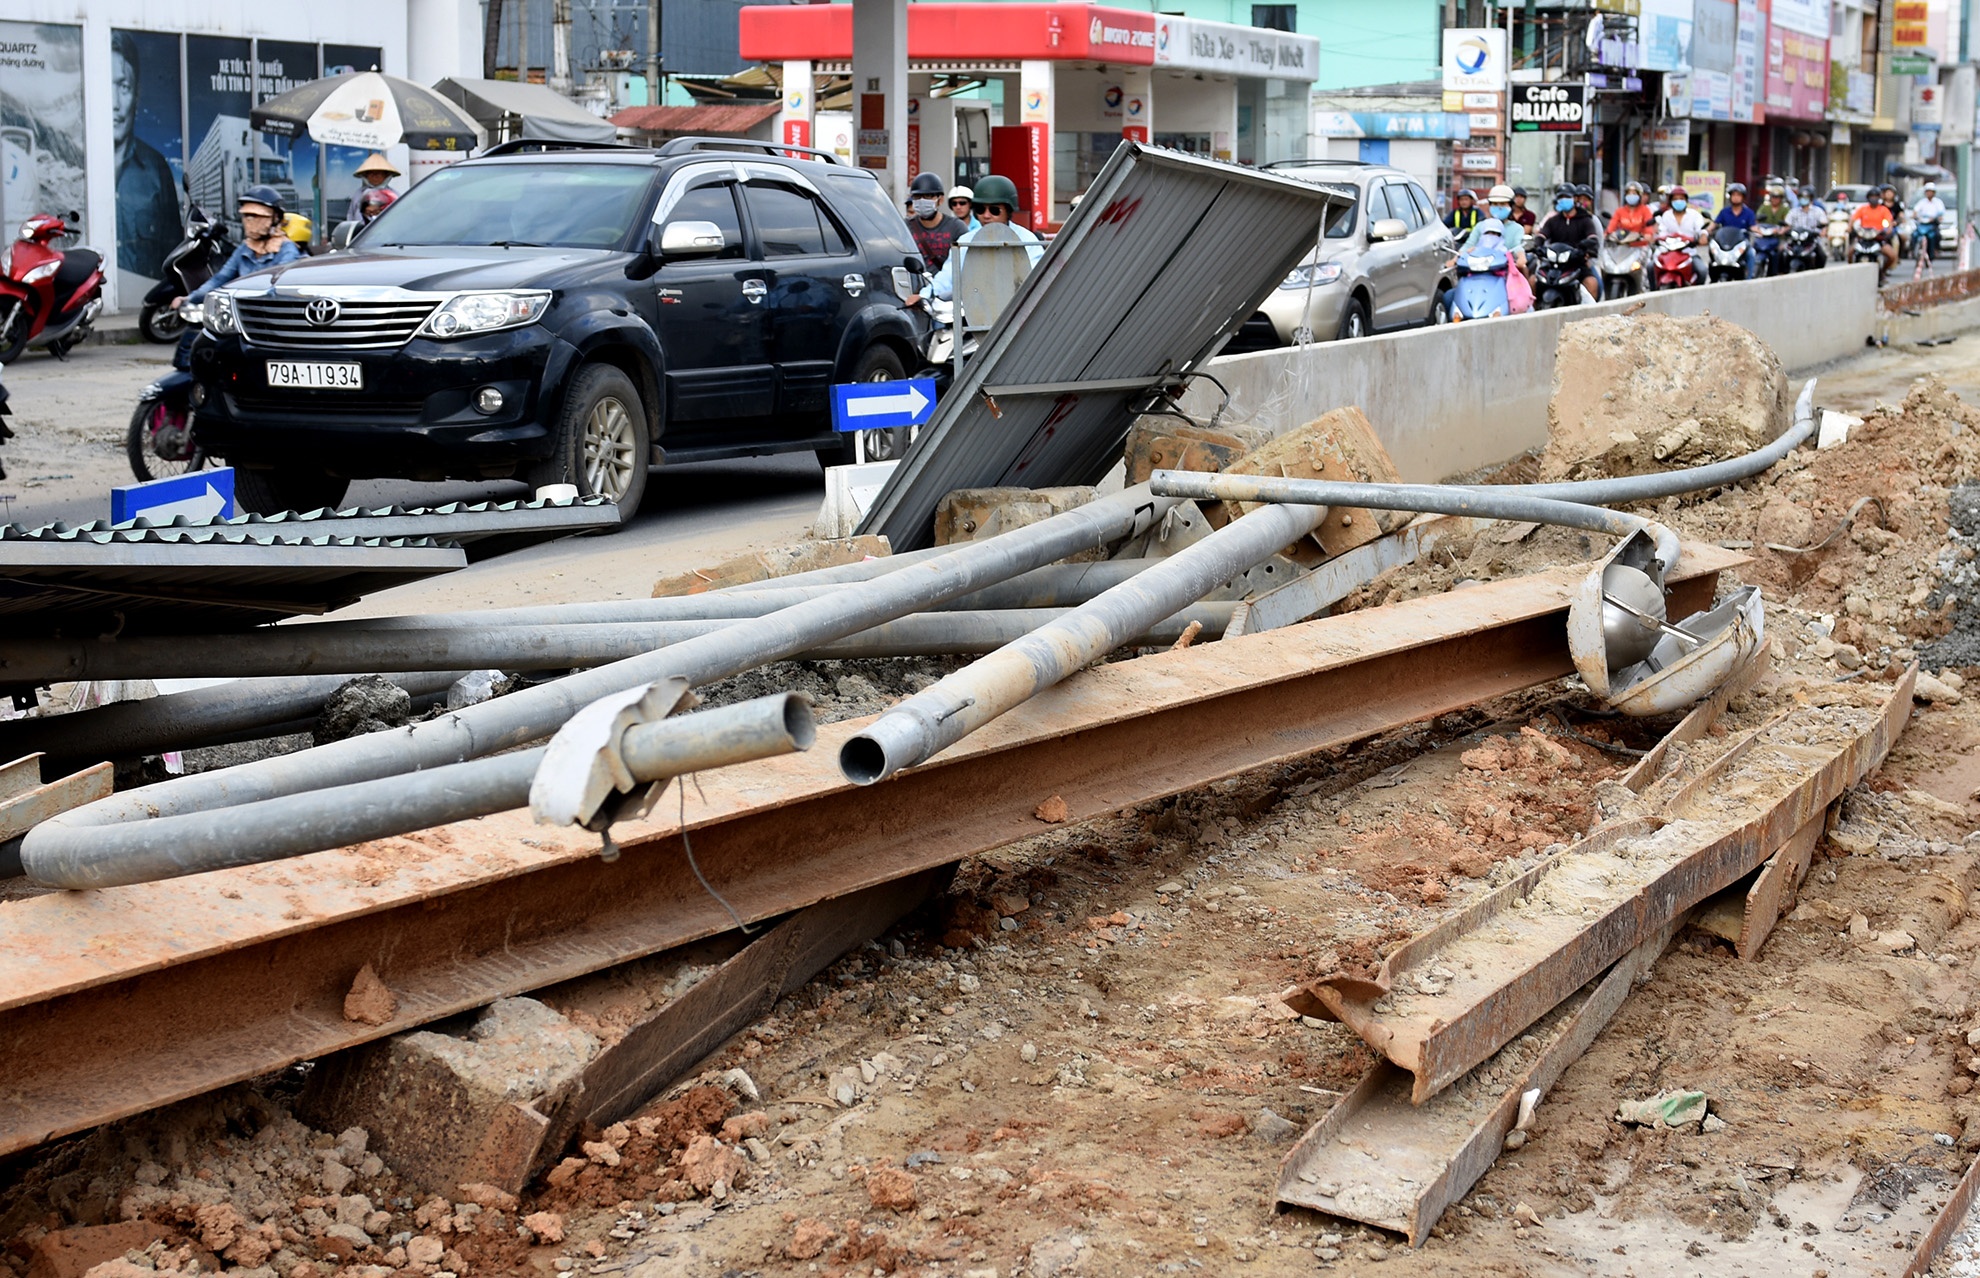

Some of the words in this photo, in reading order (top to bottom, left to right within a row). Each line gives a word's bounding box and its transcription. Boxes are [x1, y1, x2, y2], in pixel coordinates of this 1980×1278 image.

[1103, 27, 1130, 45] MOTO
[1131, 30, 1154, 47] ZONE
[0, 42, 37, 54] QUARTZ
[1219, 36, 1235, 60] Xe
[1249, 41, 1275, 69] Thay
[219, 59, 229, 73] XE
[210, 73, 227, 91] TÔI
[228, 75, 243, 92] TIN
[1526, 86, 1569, 102] Cafe
[1513, 102, 1582, 121] BILLIARD
[1386, 117, 1425, 132] ATM
[791, 124, 801, 159] ZNE
[908, 129, 918, 162] ZONE
[269, 363, 359, 386] 79A-119.34
